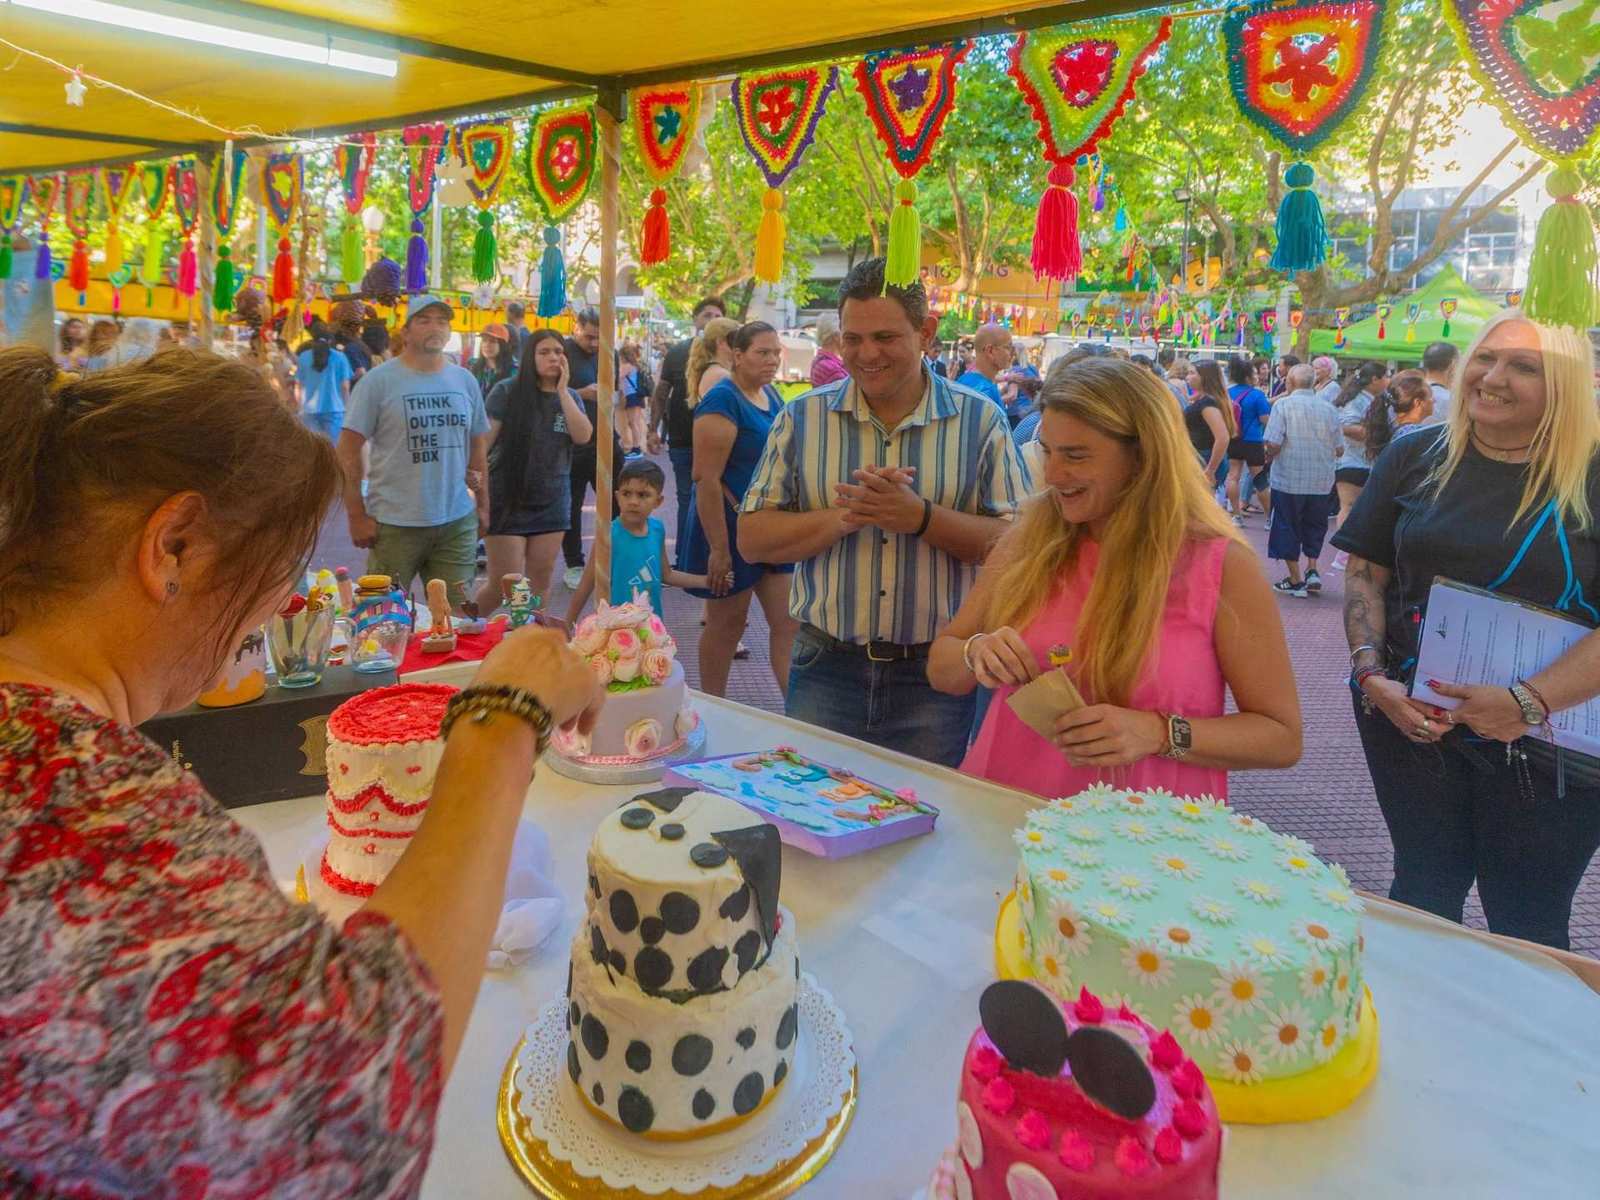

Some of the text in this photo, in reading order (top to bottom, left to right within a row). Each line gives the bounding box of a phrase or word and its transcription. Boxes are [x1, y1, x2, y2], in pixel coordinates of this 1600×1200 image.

[407, 396, 452, 411] THINK
[410, 414, 467, 430] OUTSIDE
[410, 434, 438, 448] THE
[412, 450, 439, 464] BOX
